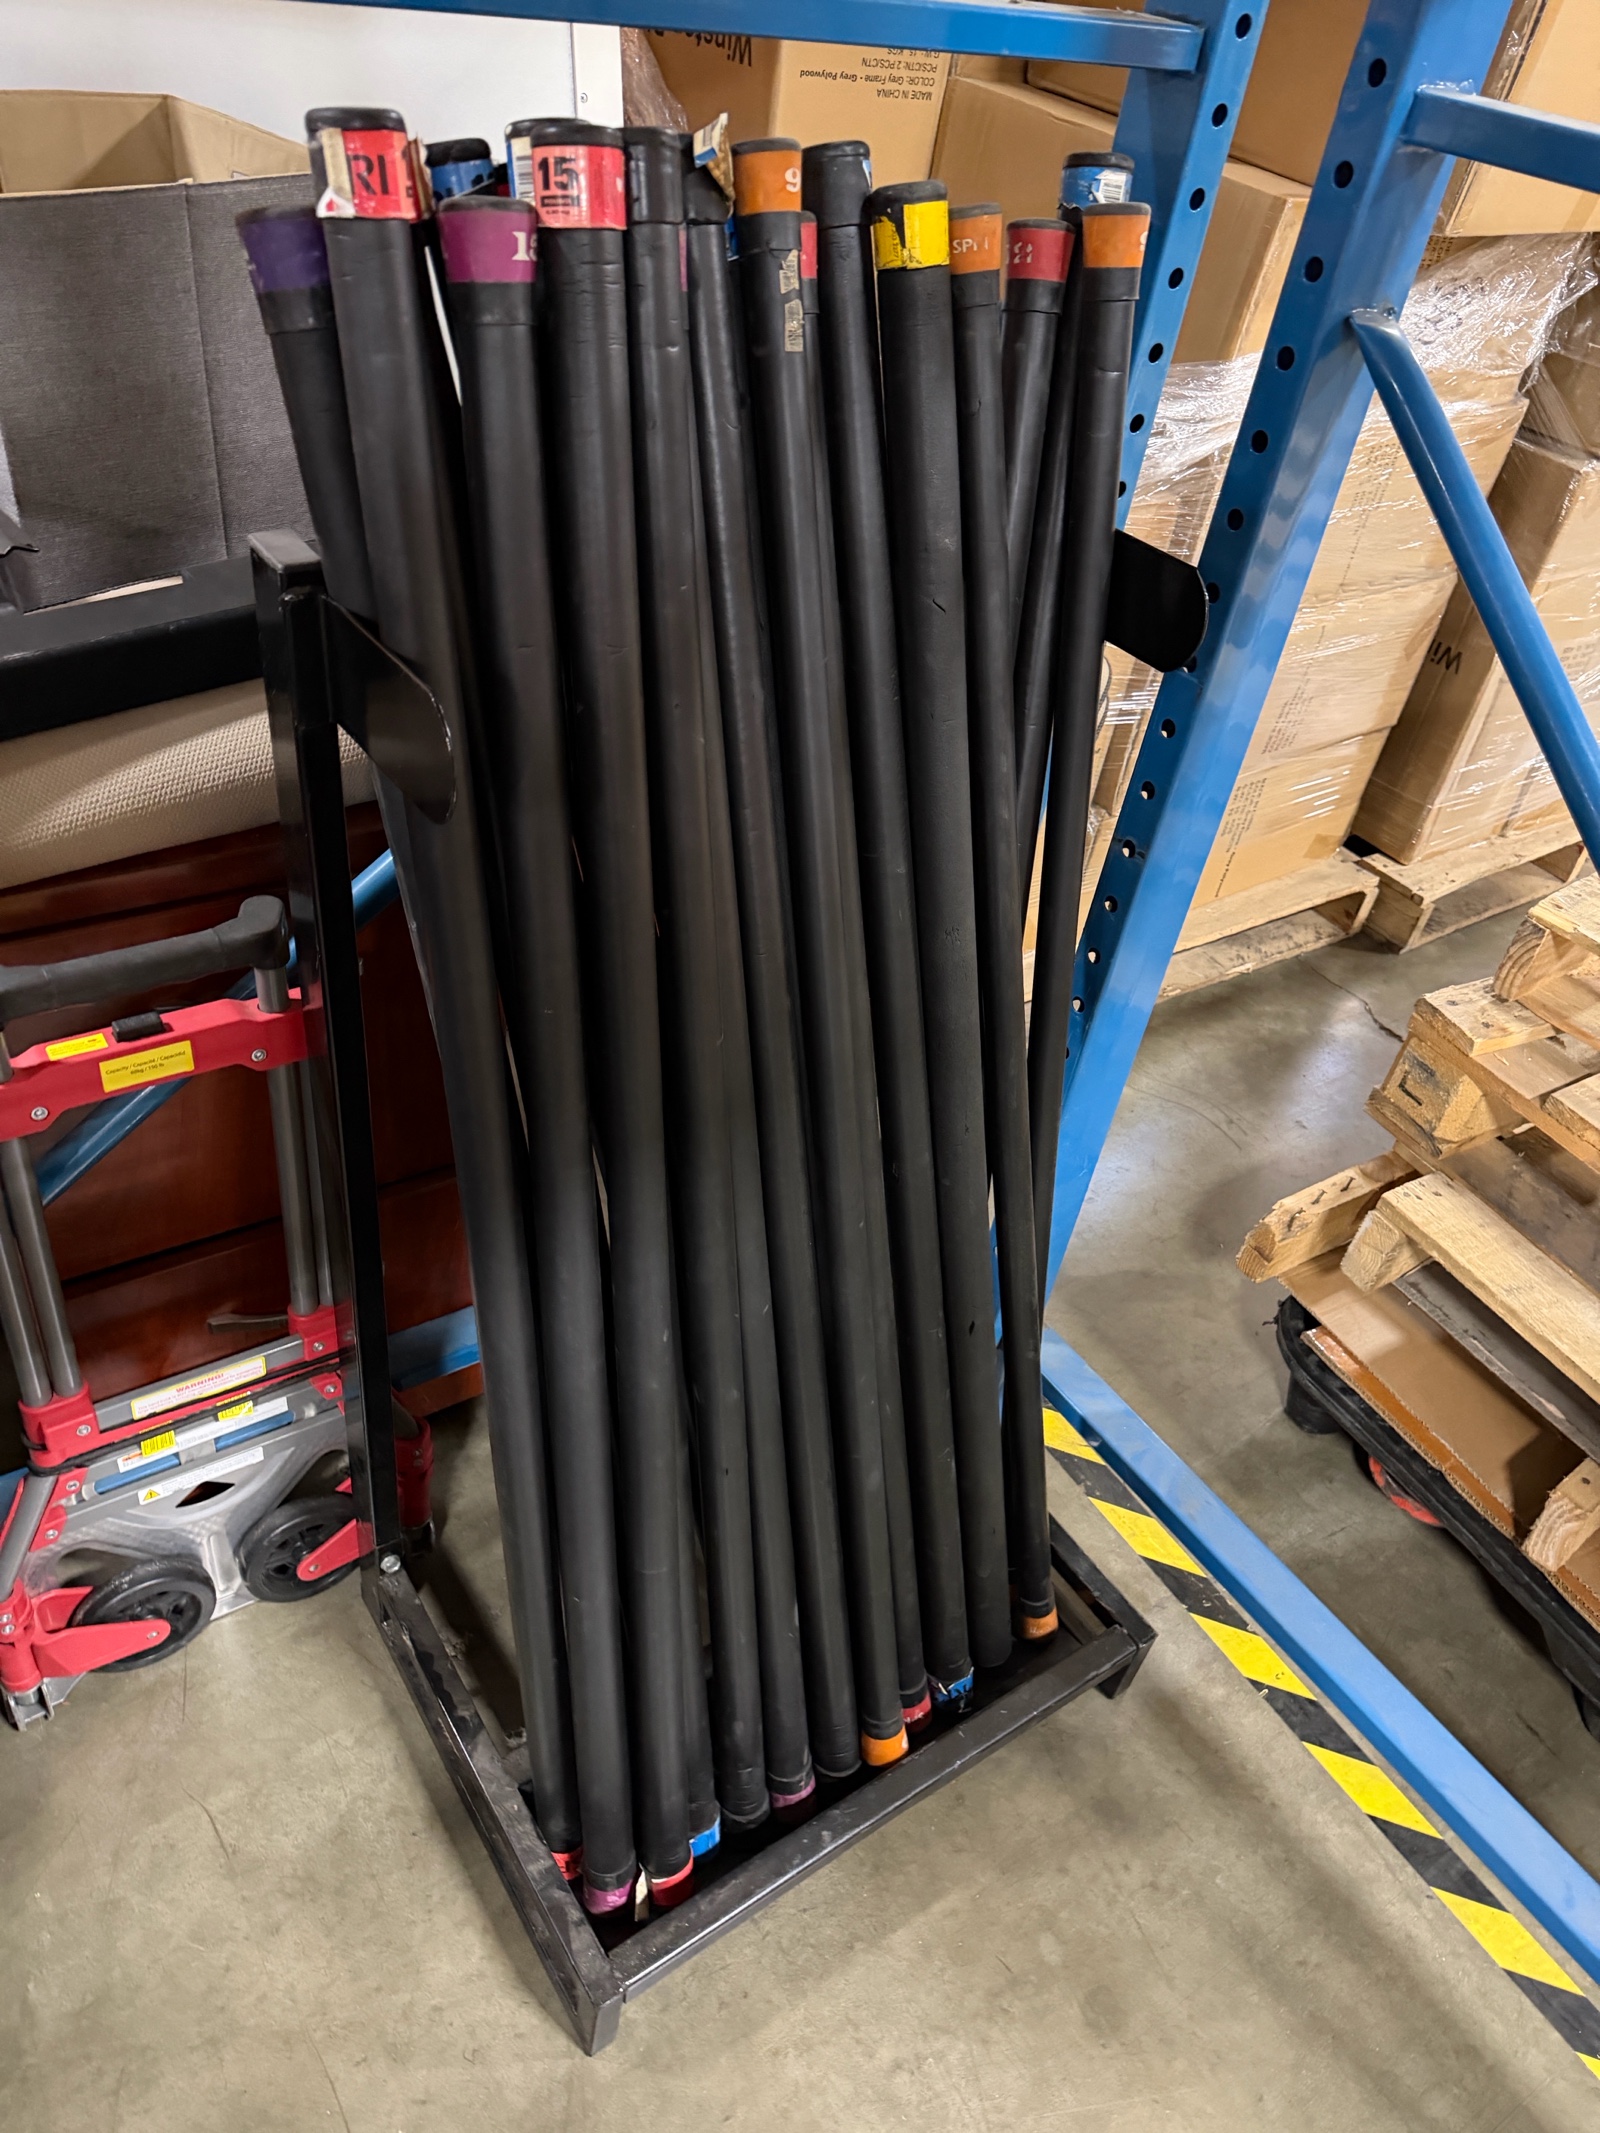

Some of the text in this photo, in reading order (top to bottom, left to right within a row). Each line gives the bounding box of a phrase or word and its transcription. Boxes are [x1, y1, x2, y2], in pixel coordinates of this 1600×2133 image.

[895, 60, 902, 71] 2
[799, 69, 838, 81] Polywood
[839, 71, 858, 83] Grey
[864, 74, 887, 85] Frame
[887, 74, 905, 86] Grey
[876, 88, 933, 101] MADE IN CHINA
[538, 155, 579, 192] 15
